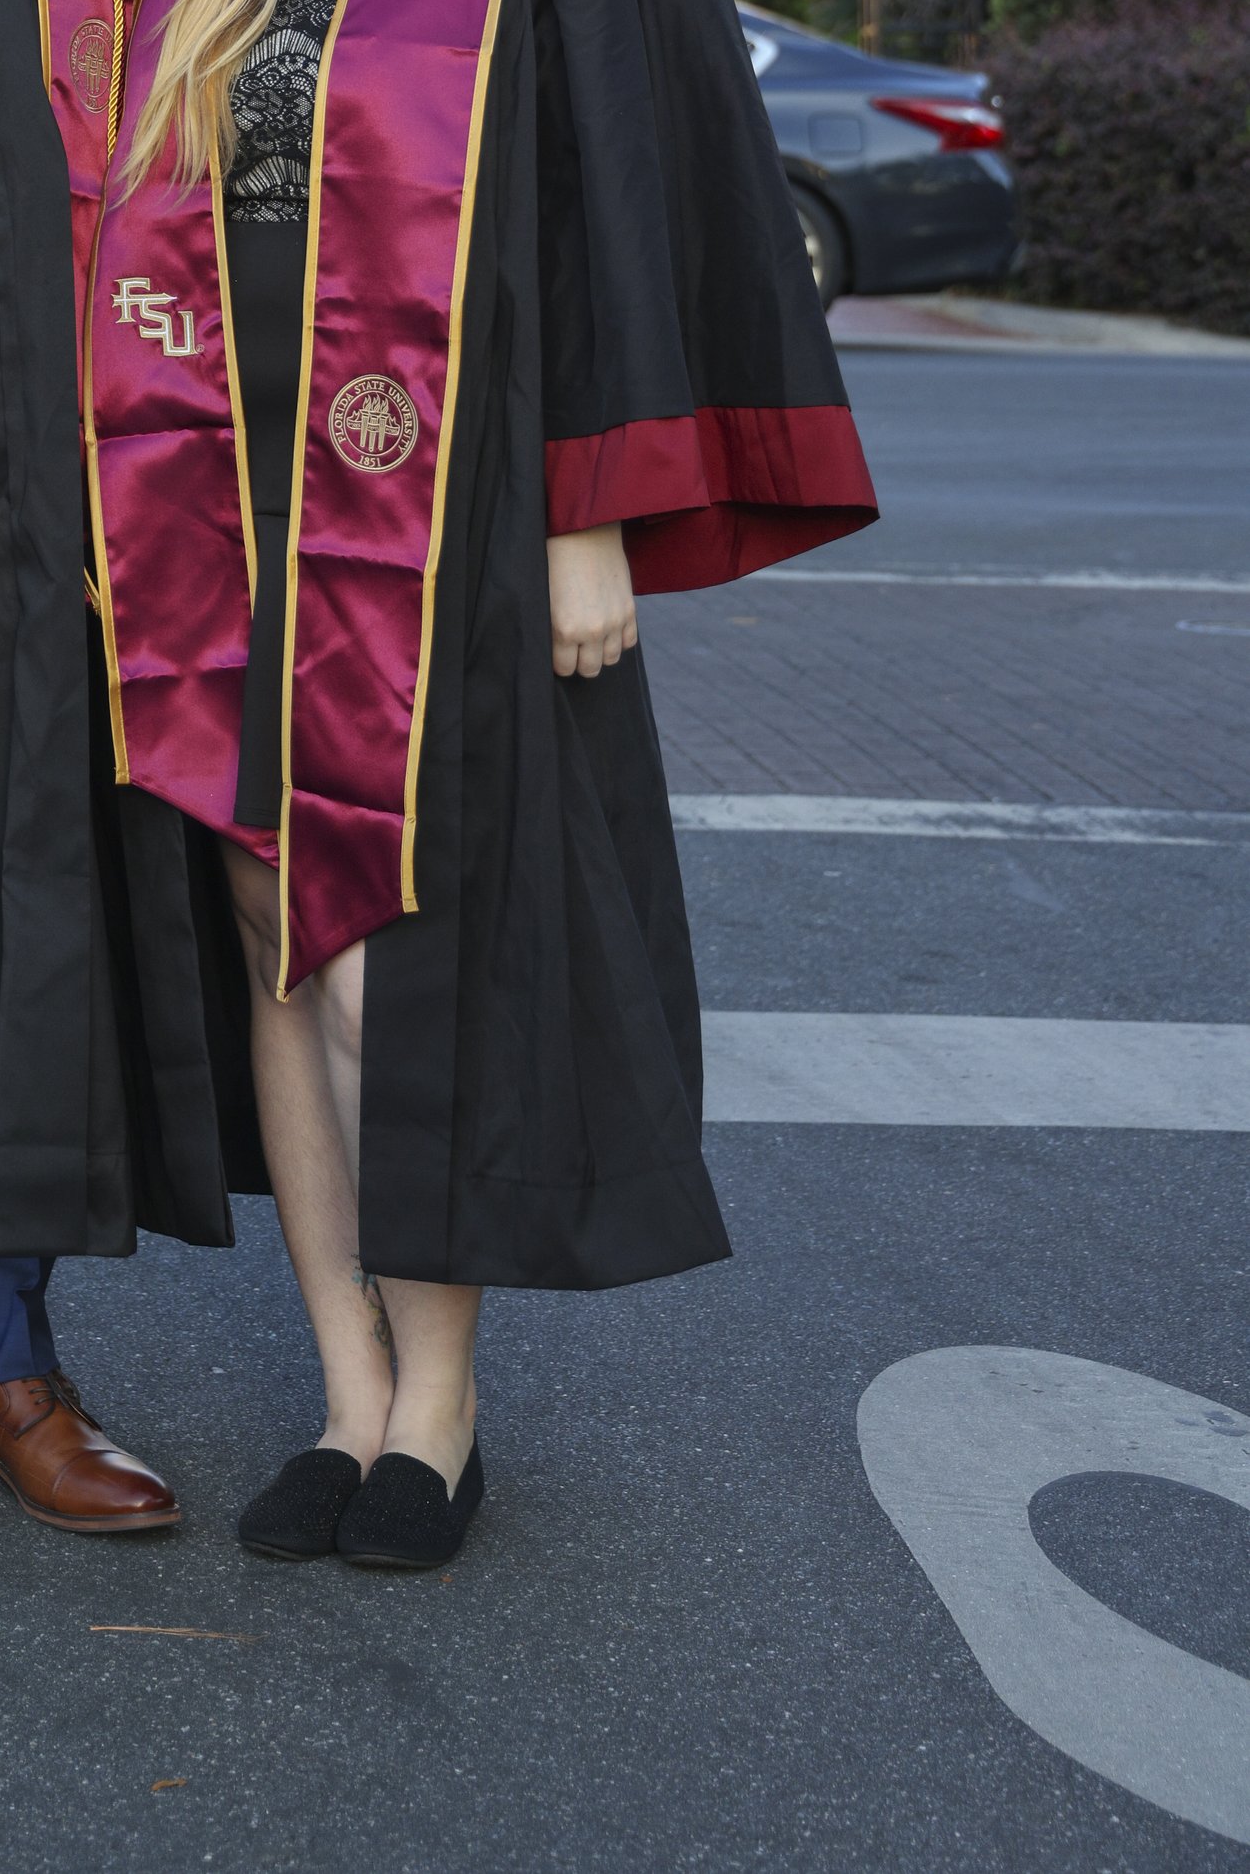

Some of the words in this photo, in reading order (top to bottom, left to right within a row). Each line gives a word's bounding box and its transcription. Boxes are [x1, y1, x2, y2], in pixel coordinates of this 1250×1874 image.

[111, 277, 199, 357] FSU
[334, 391, 354, 444] FLORIDA
[354, 380, 386, 395] STATE
[388, 386, 413, 454] UNIVERSITY
[358, 455, 381, 467] 1851
